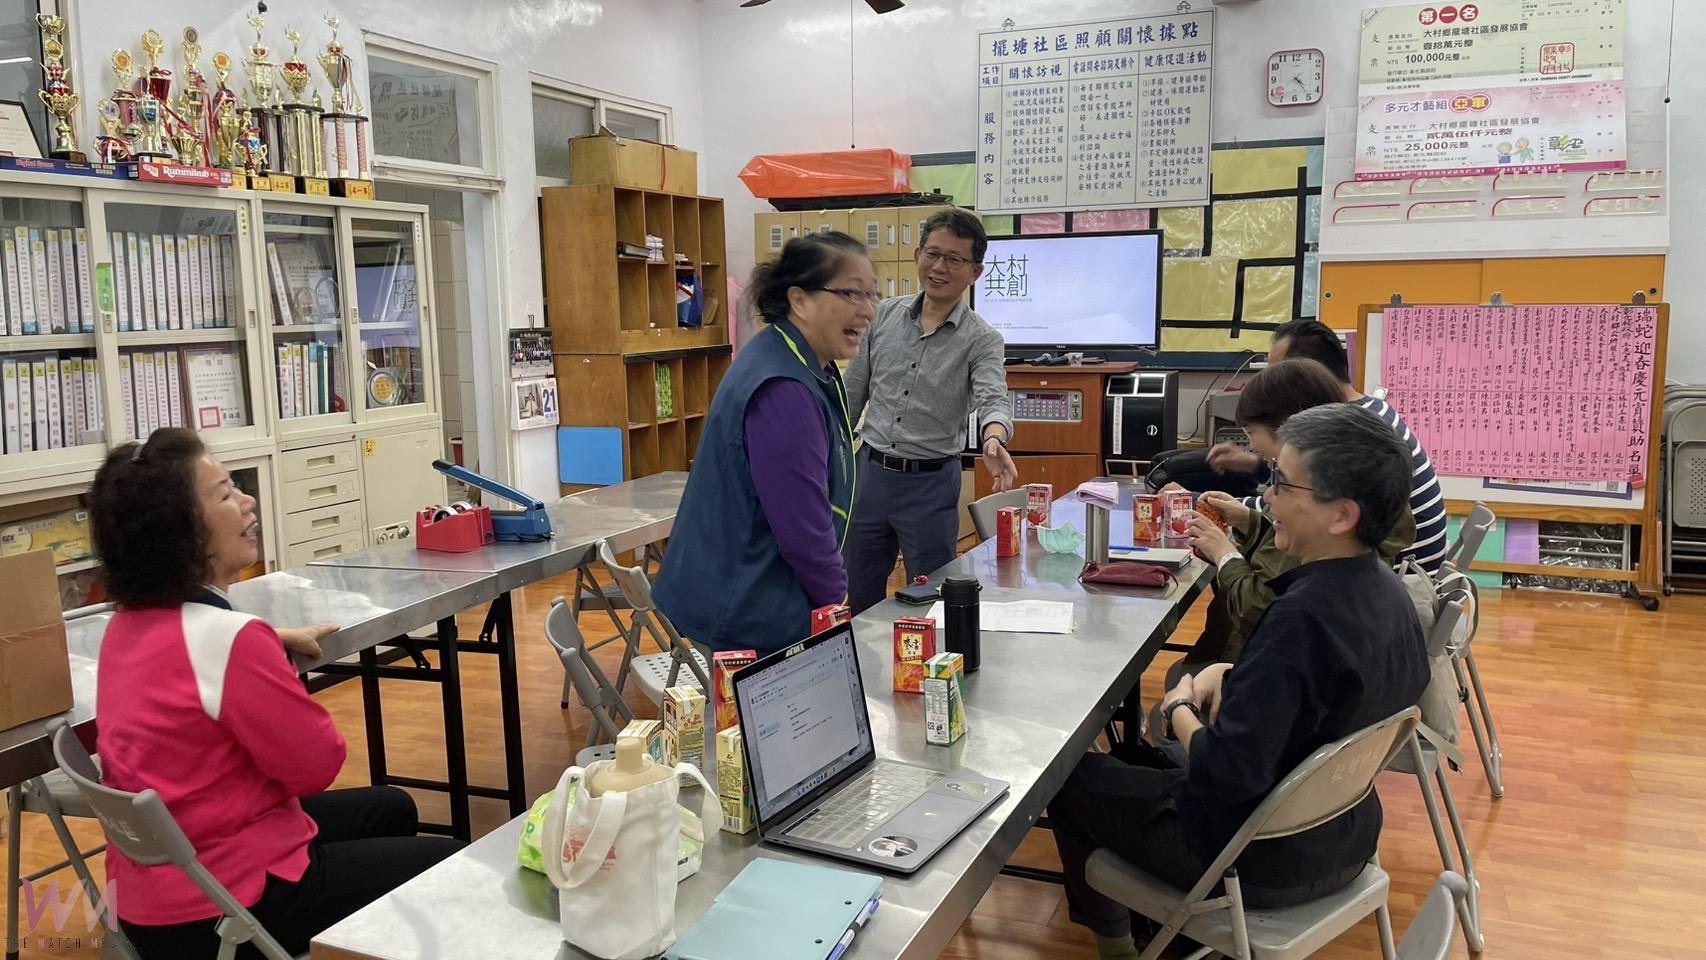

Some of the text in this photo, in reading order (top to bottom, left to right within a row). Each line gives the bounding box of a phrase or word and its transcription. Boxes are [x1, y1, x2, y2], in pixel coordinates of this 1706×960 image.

[1420, 6, 1476, 24] 第一名
[992, 22, 1199, 57] 擺塘社區照顧關懷據點
[1009, 64, 1063, 80] 關懷訪視
[1144, 51, 1207, 68] 健康促進活動
[1271, 59, 1320, 71] 10 2
[1279, 54, 1287, 62] 11
[1292, 53, 1301, 61] 12
[1406, 53, 1460, 64] 100,000元整
[1271, 72, 1320, 84] 9 3
[1384, 98, 1486, 113] 多元才藝組 亞軍
[984, 112, 996, 184] 服務內容
[1405, 142, 1469, 152] 25,000元整
[163, 166, 209, 178] Rummikub
[985, 254, 1029, 277] 大村
[984, 273, 1028, 296] 共創
[543, 388, 556, 412] 21
